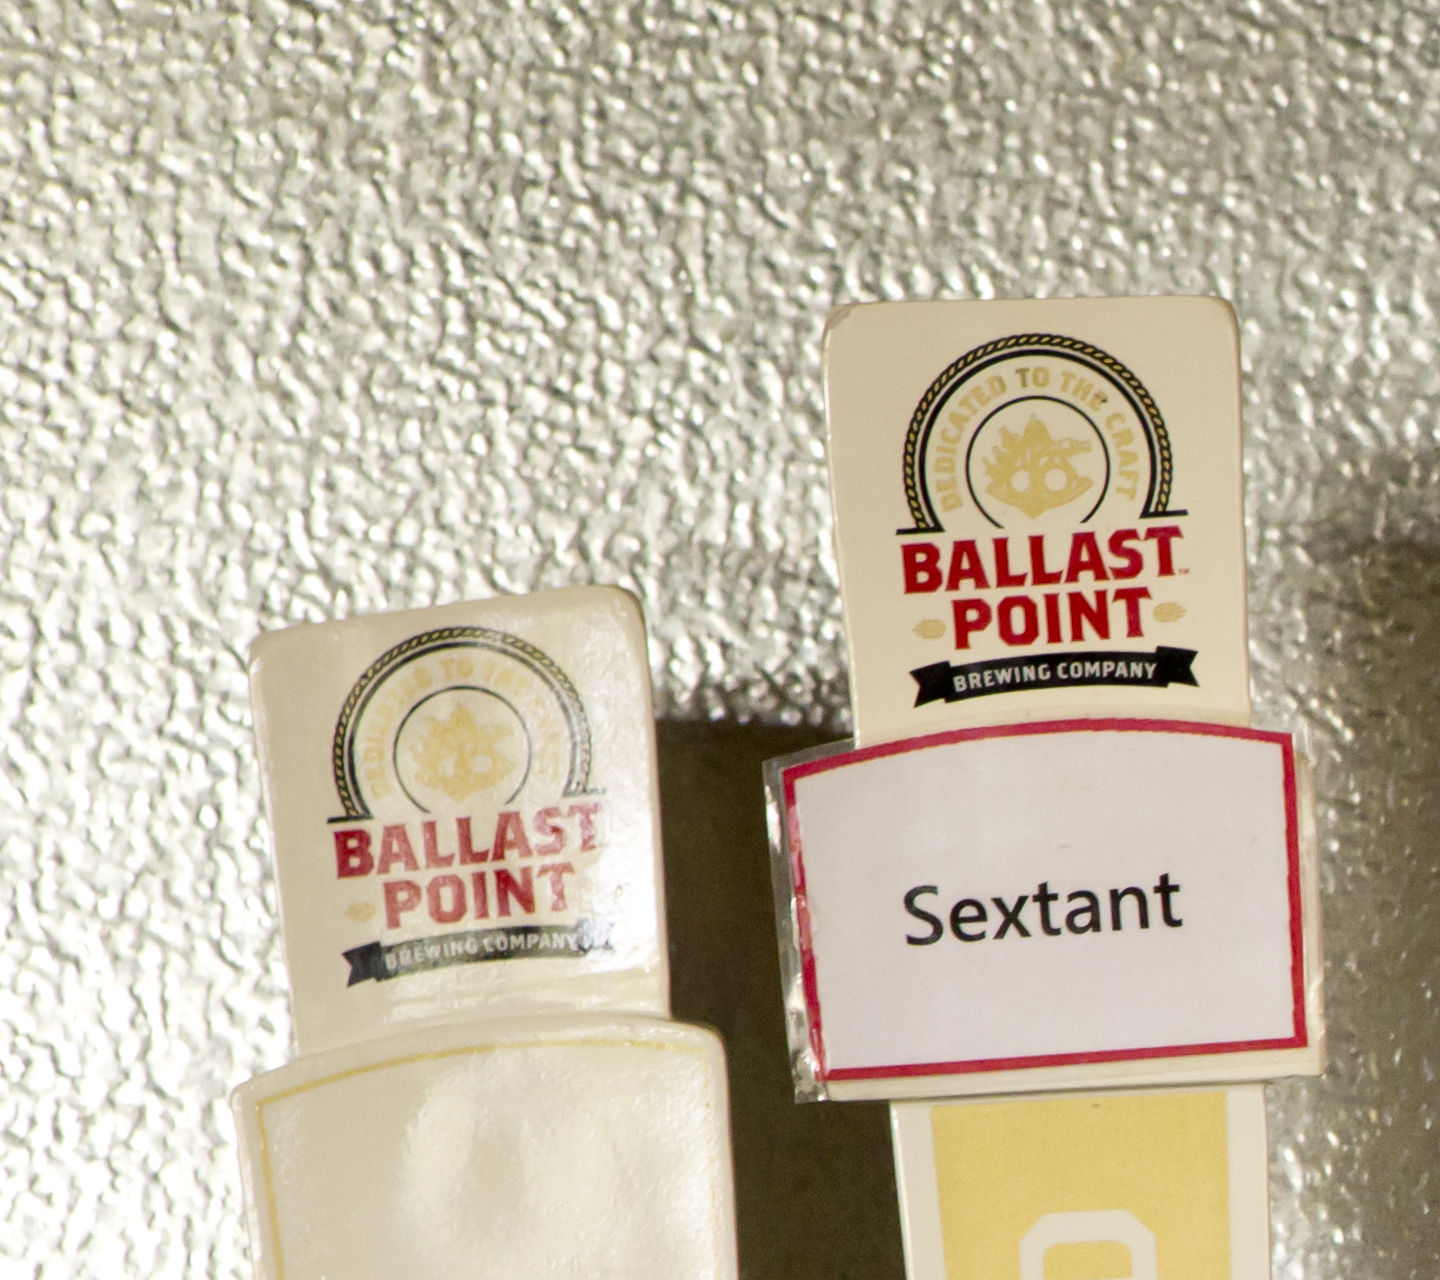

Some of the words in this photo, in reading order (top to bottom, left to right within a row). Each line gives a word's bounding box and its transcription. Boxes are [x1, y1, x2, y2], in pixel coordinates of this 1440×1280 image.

[935, 376, 1007, 512] DEDICATED
[1016, 367, 1050, 388] TO
[1059, 371, 1108, 412] THE
[1104, 412, 1139, 501] CRAFT
[901, 526, 1184, 594] BALLAST
[951, 587, 1152, 650] POINT
[953, 662, 1051, 691] BREWING
[1057, 662, 1157, 679] COMPANY
[333, 803, 601, 880] BALLAST
[384, 862, 574, 930] POINT
[903, 873, 1183, 947] Sextant
[482, 930, 578, 953] COMPANY
